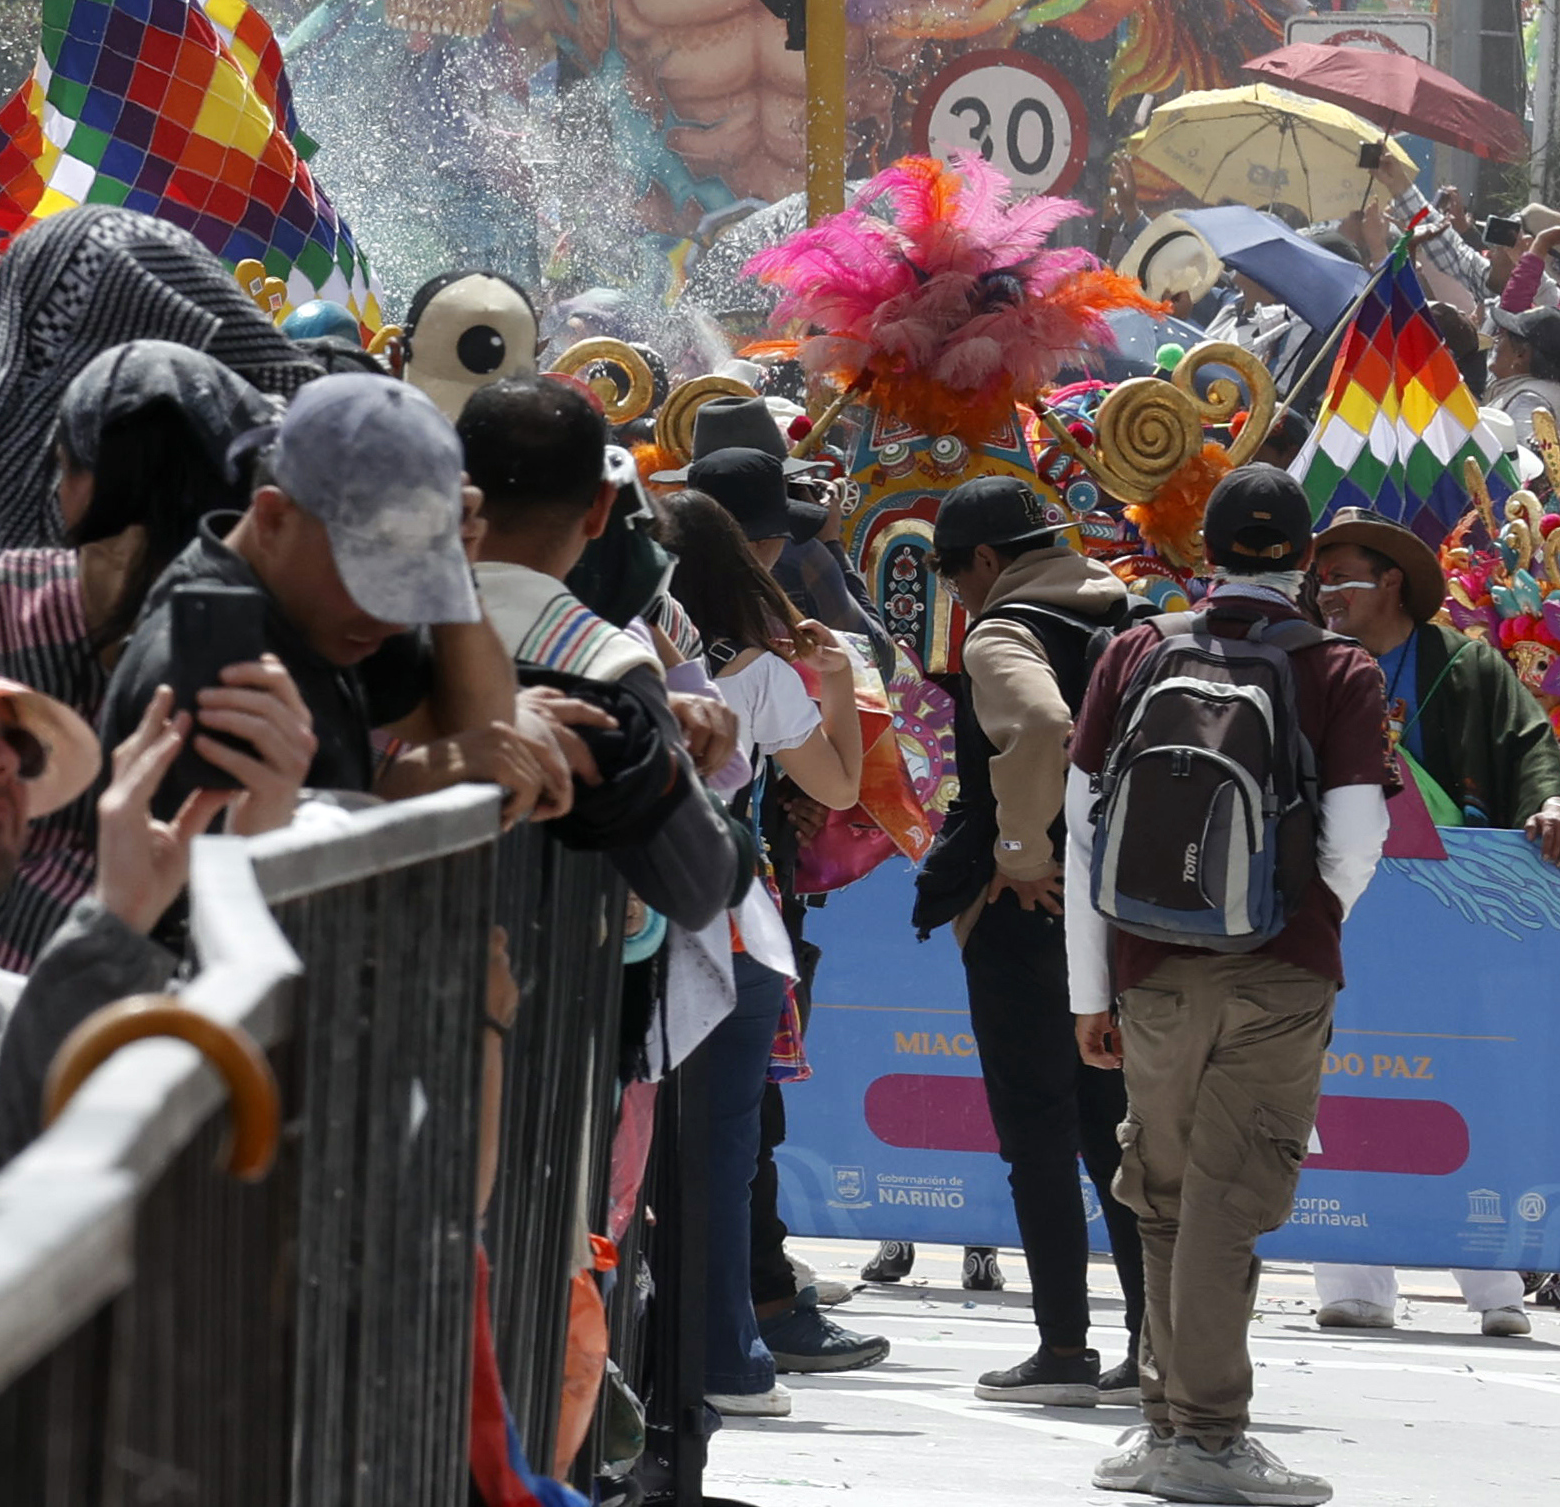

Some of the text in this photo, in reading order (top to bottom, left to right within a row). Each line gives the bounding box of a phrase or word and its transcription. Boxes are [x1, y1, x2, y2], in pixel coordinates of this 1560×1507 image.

[949, 96, 1055, 176] 30
[1183, 842, 1198, 882] TOTTO
[1371, 1054, 1434, 1080] PAZ
[876, 1173, 964, 1187] Gobernación de
[878, 1186, 965, 1209] NARIÑO
[1290, 1212, 1369, 1228] carnaval
